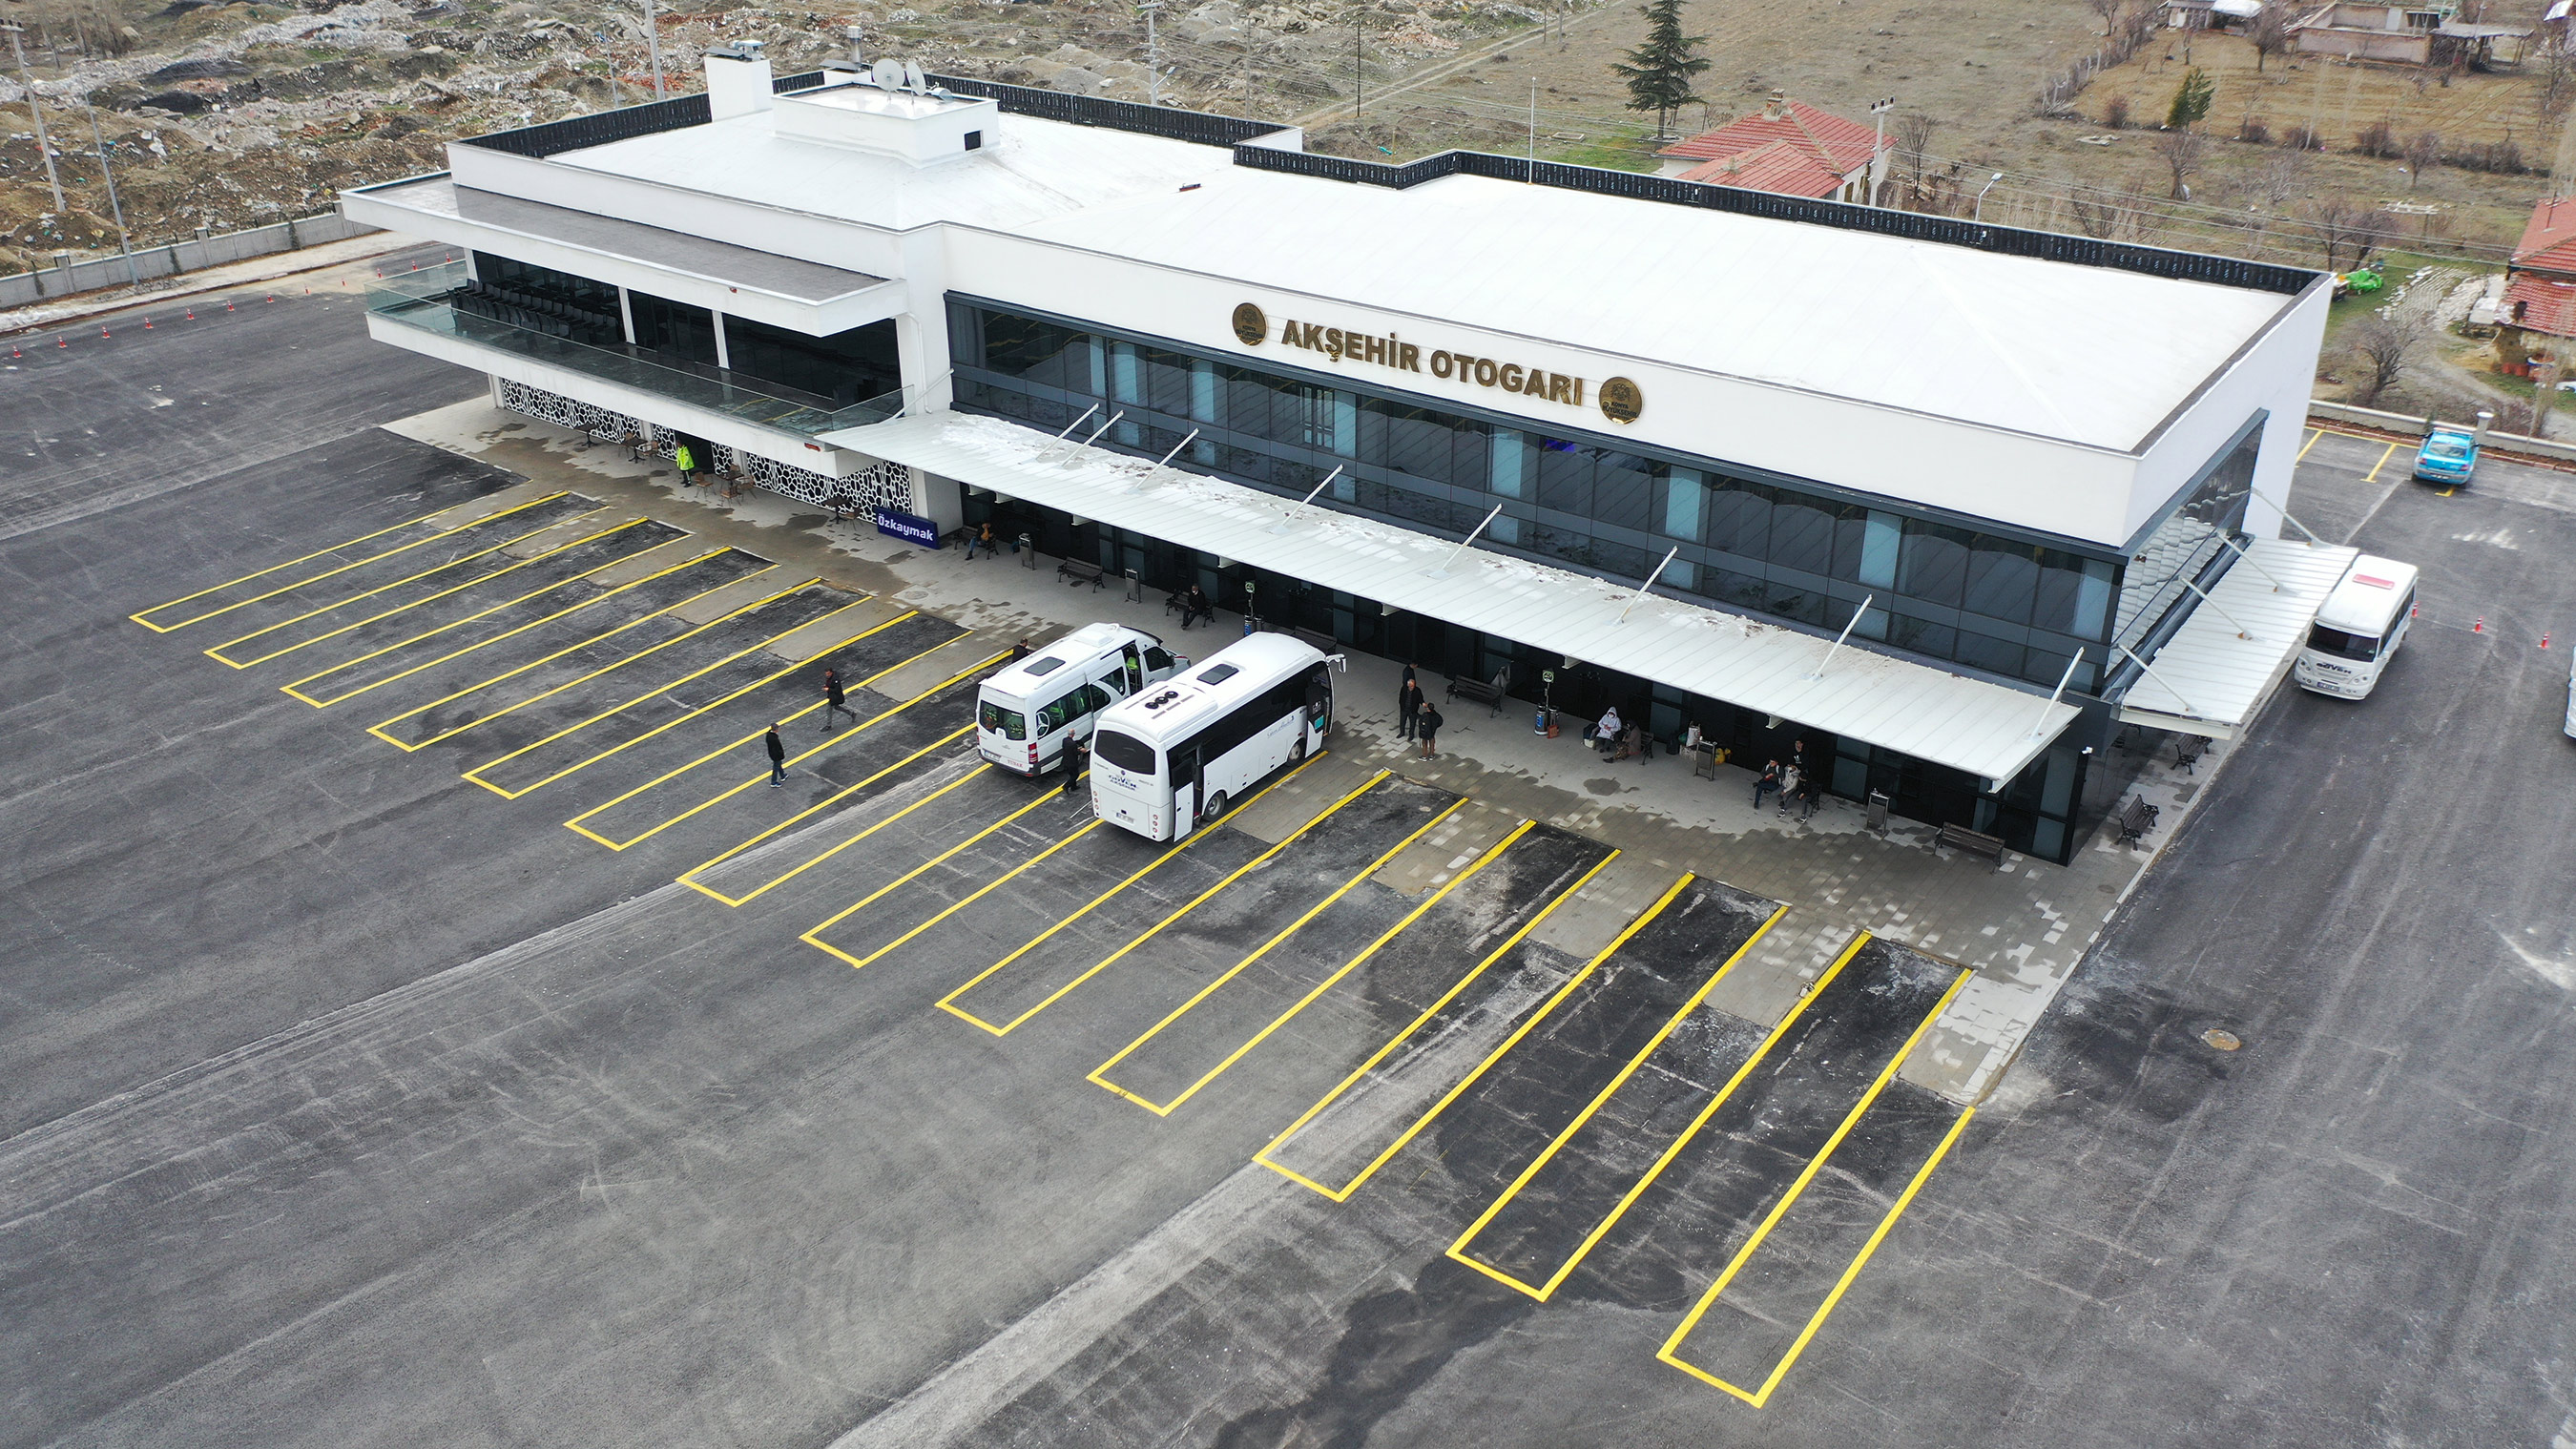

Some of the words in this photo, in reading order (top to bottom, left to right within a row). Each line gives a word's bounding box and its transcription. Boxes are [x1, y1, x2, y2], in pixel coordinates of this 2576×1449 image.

[1281, 320, 1420, 373] AKŞEHİR
[1430, 350, 1584, 406] OTOGARI
[1611, 401, 1629, 409] KONYA
[878, 513, 933, 541] Özkaymak
